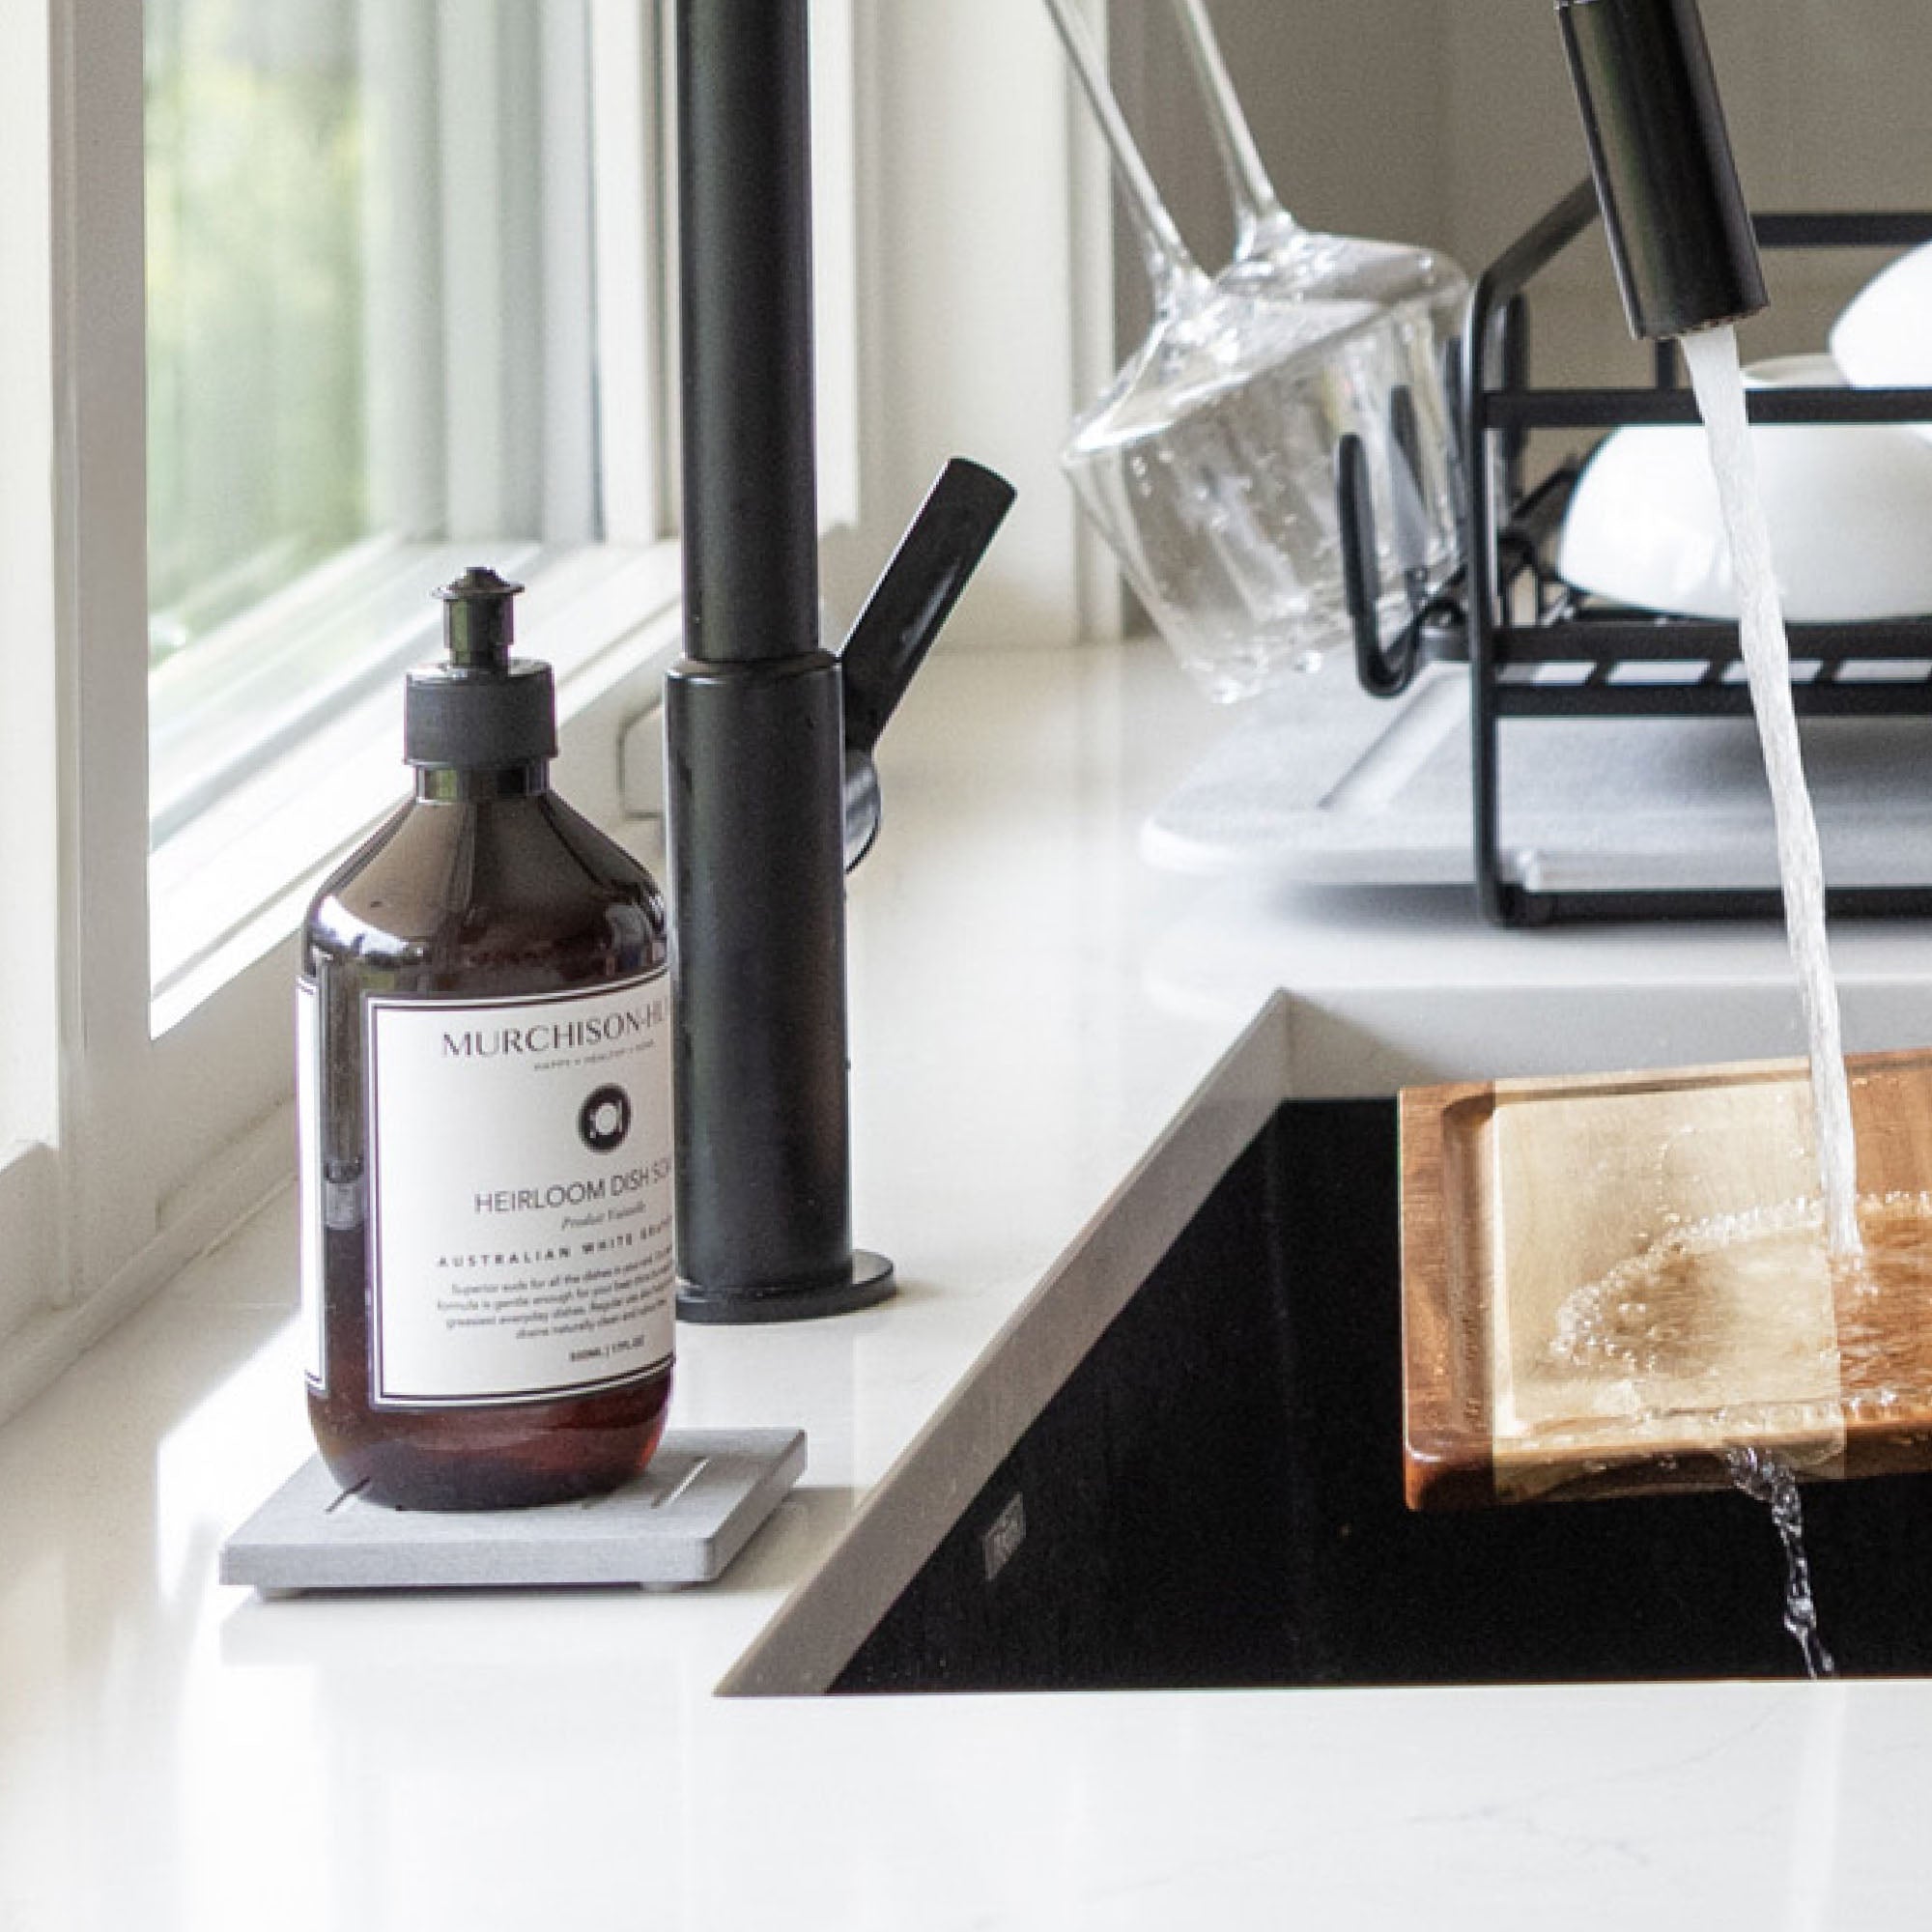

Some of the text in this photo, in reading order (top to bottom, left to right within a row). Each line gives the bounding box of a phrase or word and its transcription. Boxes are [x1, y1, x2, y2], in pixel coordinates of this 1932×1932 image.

[474, 1179, 605, 1213] HEIRLOOM
[611, 1166, 649, 1197] DISH
[438, 1246, 572, 1266] AUSTRALIAN
[582, 1232, 633, 1255] WHITE
